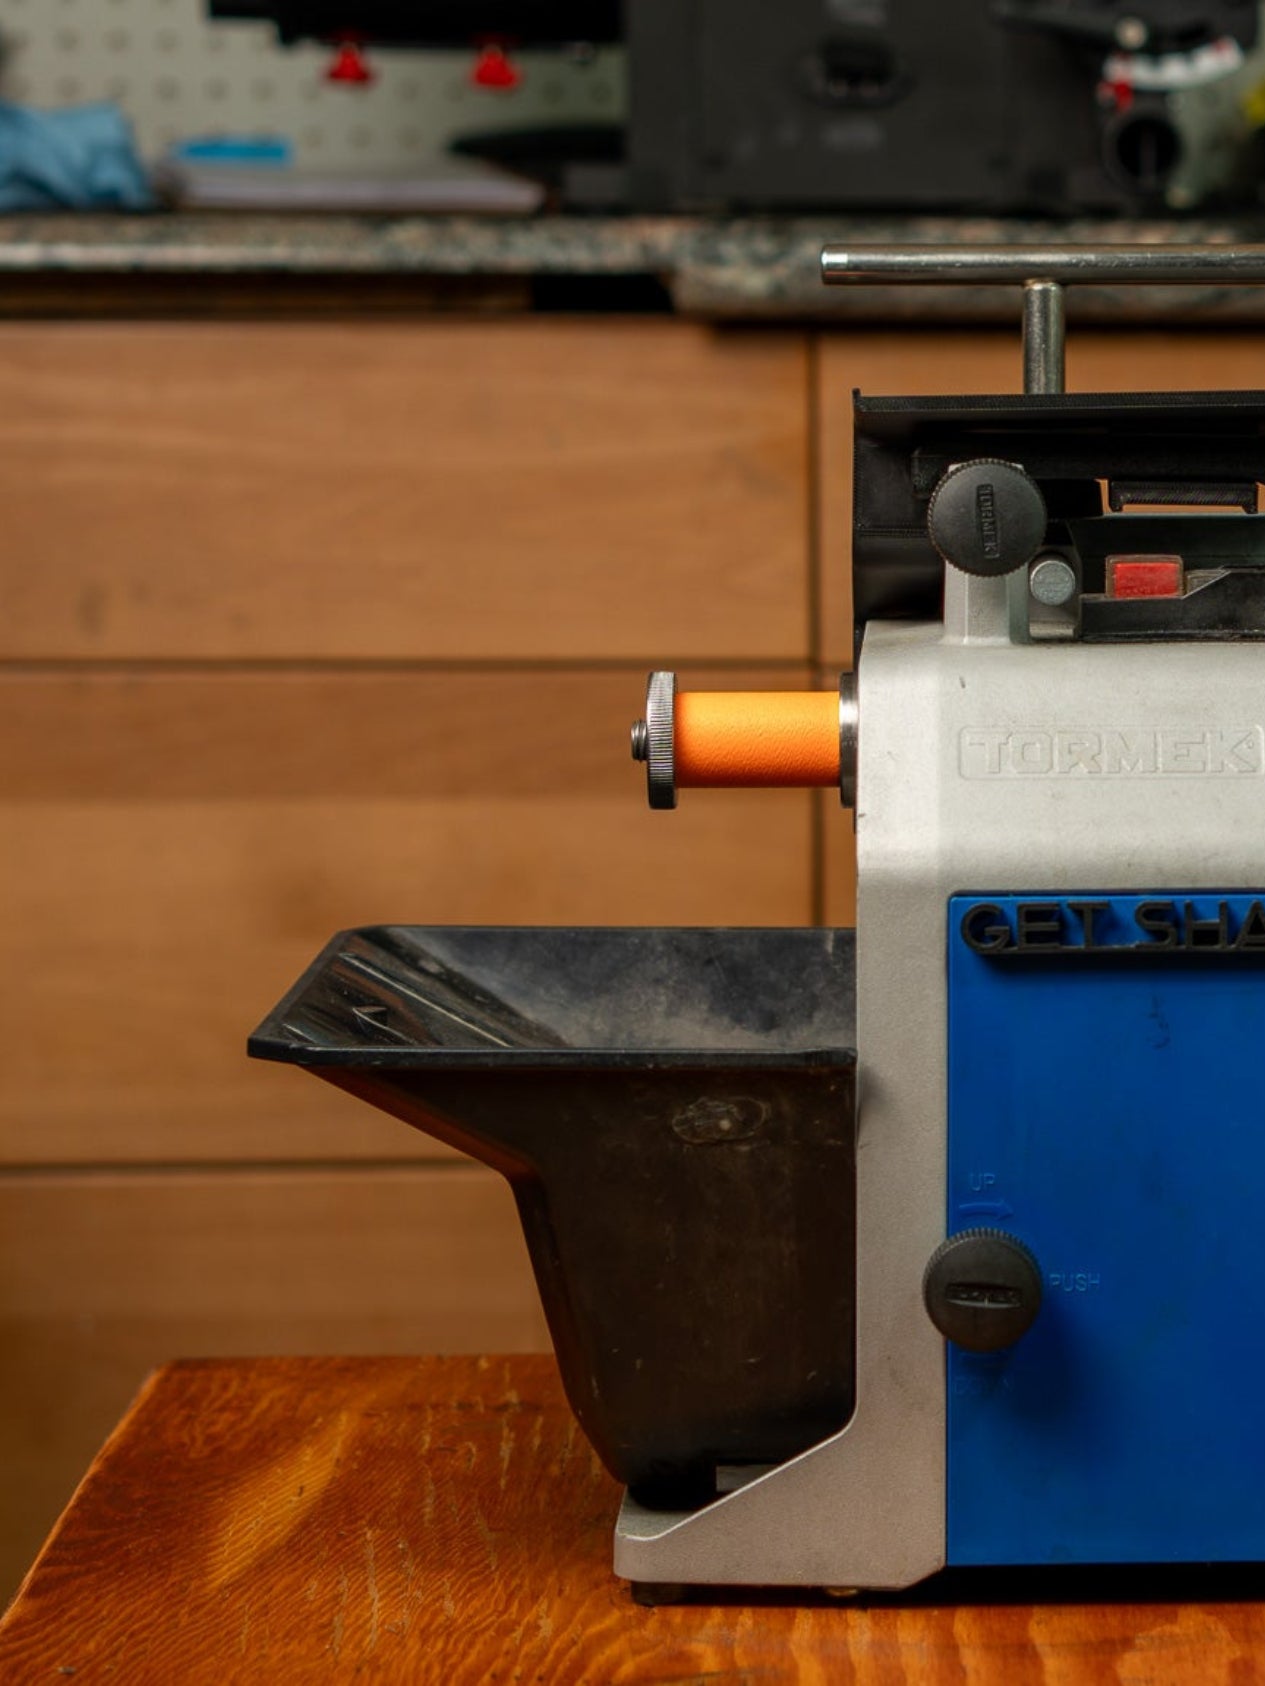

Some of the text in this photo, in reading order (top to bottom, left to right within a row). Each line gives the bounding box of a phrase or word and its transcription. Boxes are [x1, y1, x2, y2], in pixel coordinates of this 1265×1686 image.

[967, 730, 1258, 774] TORMEK
[961, 901, 1110, 953] GET
[969, 1172, 996, 1192] UP
[1048, 1273, 1101, 1292] PUSH
